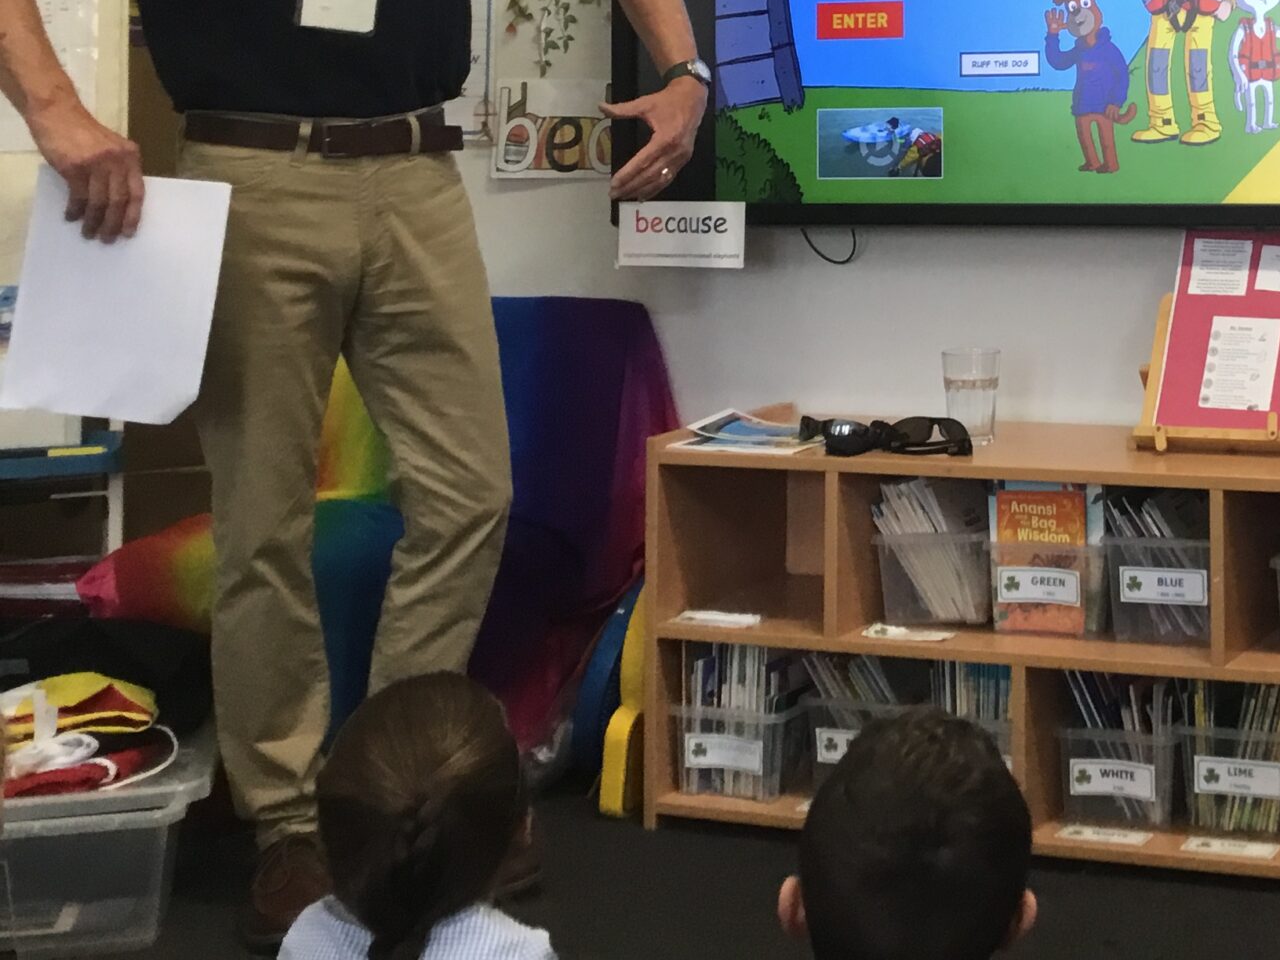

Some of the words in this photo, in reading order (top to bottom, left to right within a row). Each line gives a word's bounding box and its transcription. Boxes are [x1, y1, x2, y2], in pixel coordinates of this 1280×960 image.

[832, 12, 888, 29] ENTER
[971, 60, 991, 68] RUFF
[636, 210, 728, 234] because
[1011, 501, 1056, 515] Anansi
[1032, 516, 1056, 531] Bag
[1018, 528, 1070, 543] Wisdom
[1031, 576, 1065, 587] GREEN
[1157, 577, 1184, 588] BLUE
[1099, 769, 1135, 781] WHITE
[1228, 767, 1254, 778] LIME
